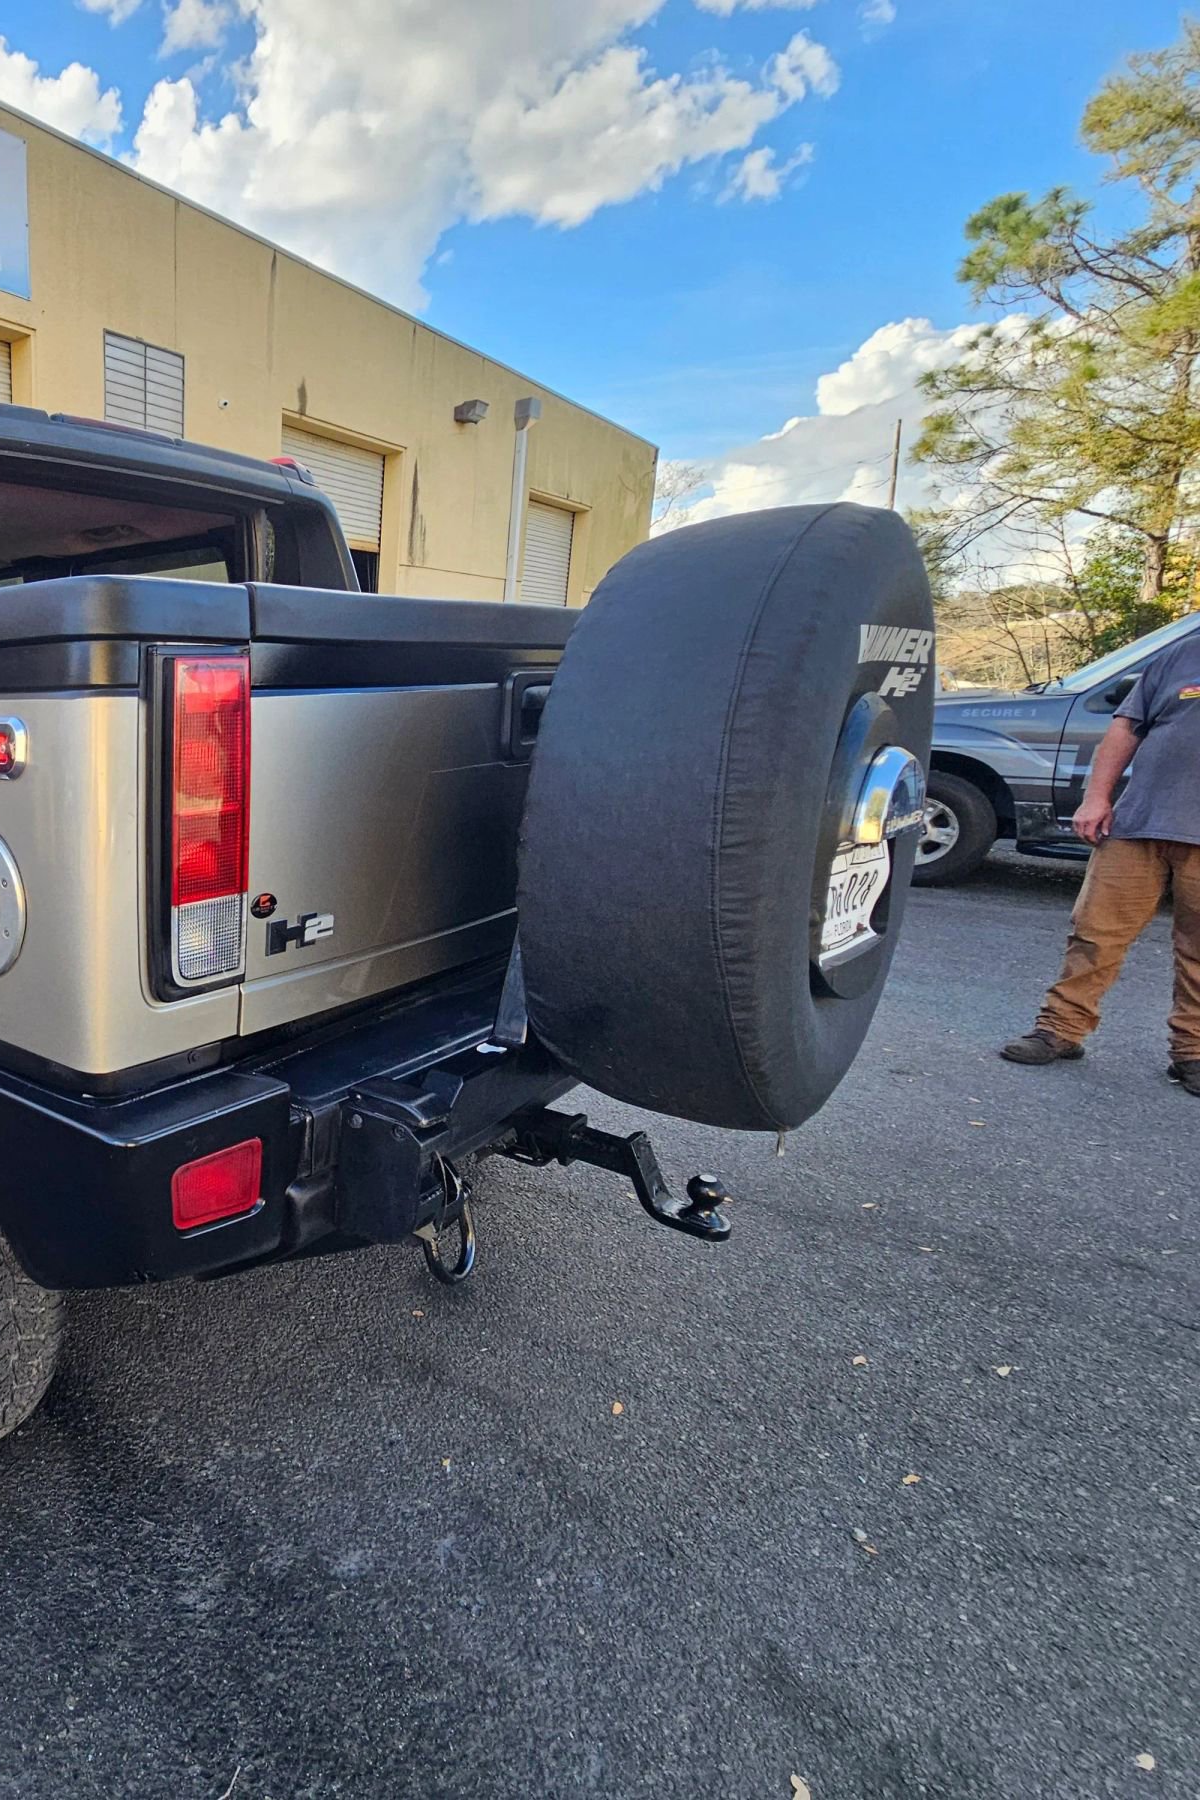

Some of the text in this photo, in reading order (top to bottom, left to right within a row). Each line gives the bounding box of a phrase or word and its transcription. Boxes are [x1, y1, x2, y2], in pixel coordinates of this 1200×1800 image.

[961, 708, 1037, 717] SECURE 1
[265, 913, 335, 956] H2
